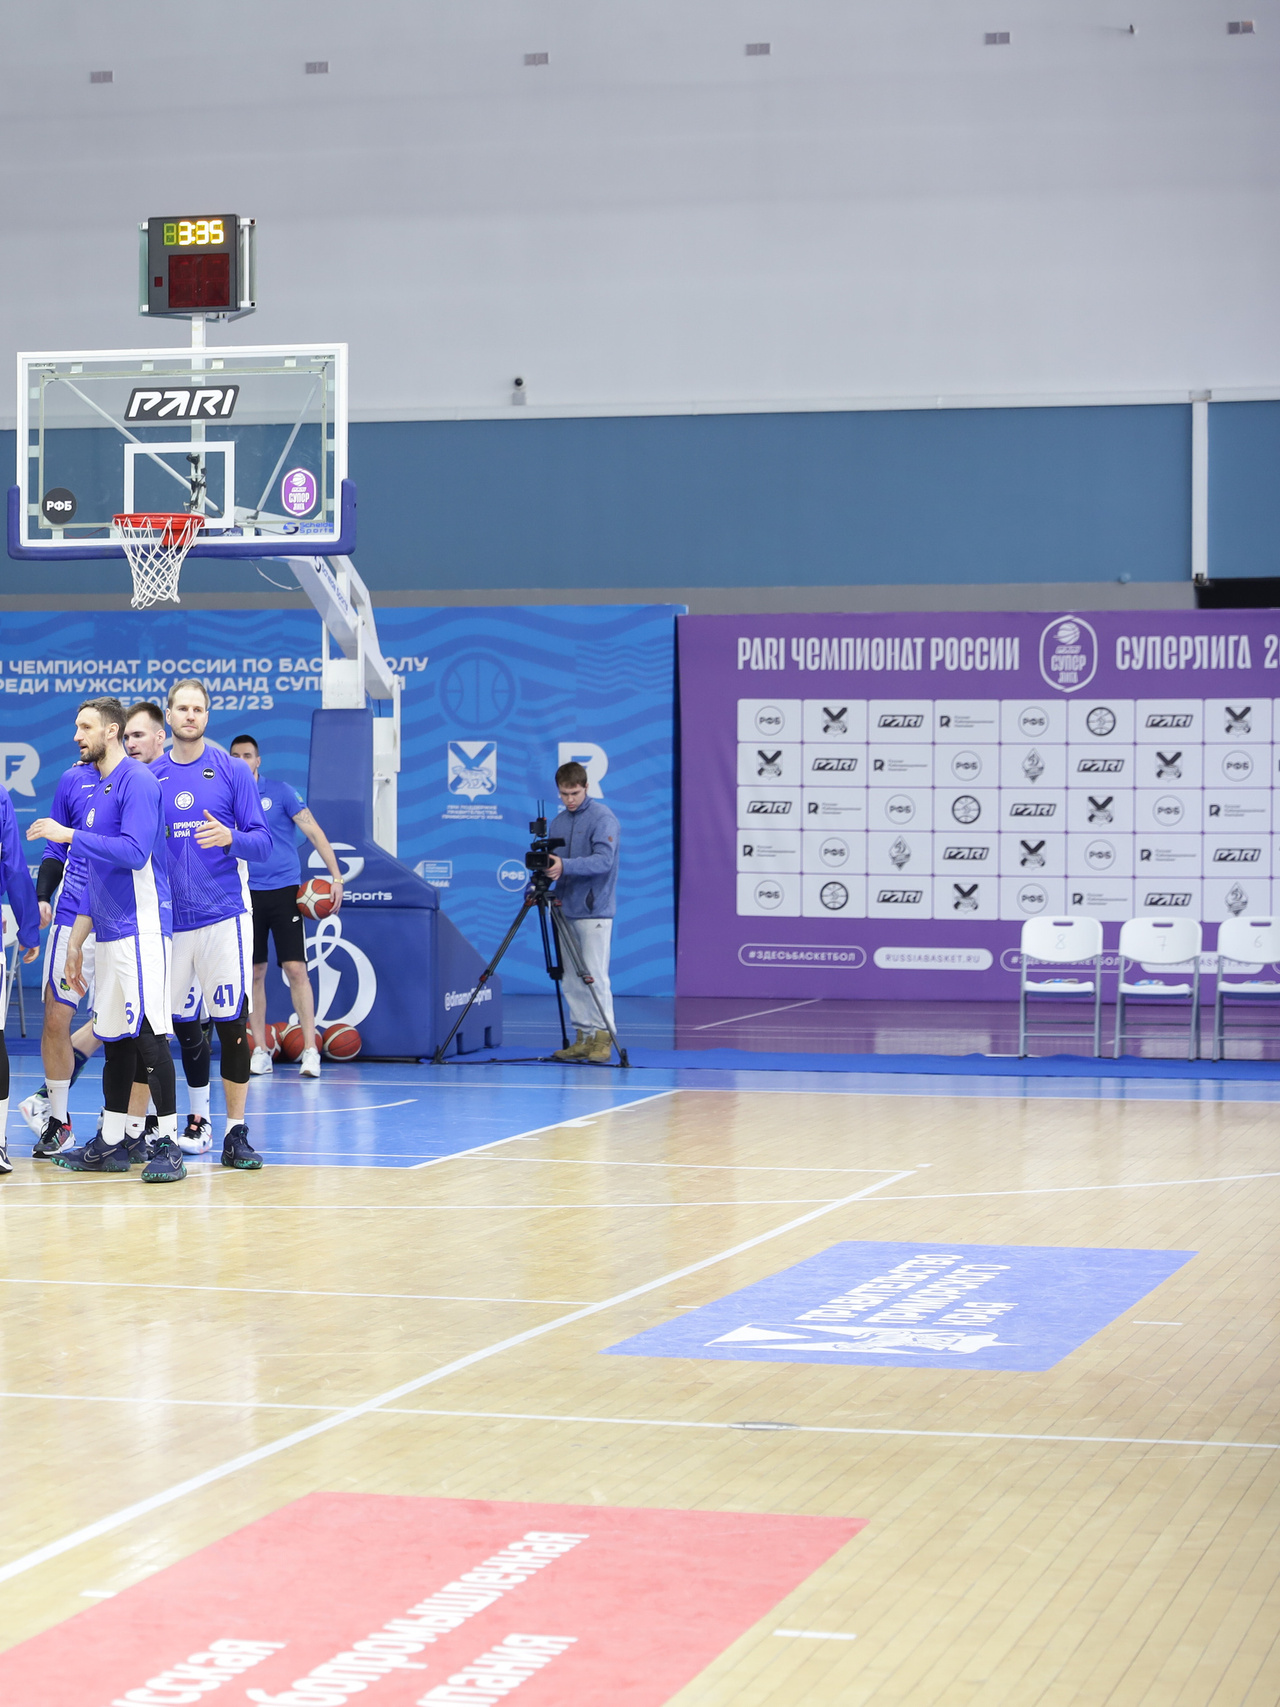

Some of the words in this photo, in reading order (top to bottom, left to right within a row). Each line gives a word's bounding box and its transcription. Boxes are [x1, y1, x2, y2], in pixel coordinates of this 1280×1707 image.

[127, 388, 236, 418] PARI
[46, 500, 73, 511] РФБ
[737, 637, 785, 671] PARI
[930, 637, 1020, 671] РОССИИ
[1264, 634, 1280, 669] 2
[9, 659, 141, 674] ЧЕМПИОНАТ
[147, 658, 236, 674] РОССИИ
[242, 658, 273, 673] ПО
[55, 677, 167, 693] МУЖСКИХ
[877, 715, 924, 728] PARI
[1145, 714, 1193, 728] PARI
[812, 758, 858, 771] PARI
[1077, 759, 1125, 772] PARI
[746, 800, 792, 814] PARI
[1009, 803, 1057, 817] PARI
[174, 829, 191, 838] КРАЙ
[942, 847, 990, 860] PARI
[1212, 848, 1261, 862] PARI
[501, 871, 526, 880] РФБ
[342, 891, 393, 903] Sports
[876, 889, 923, 904] PARI
[1144, 892, 1192, 907] PARI
[213, 984, 234, 1008] 41
[932, 1301, 1019, 1327] КРАЯ
